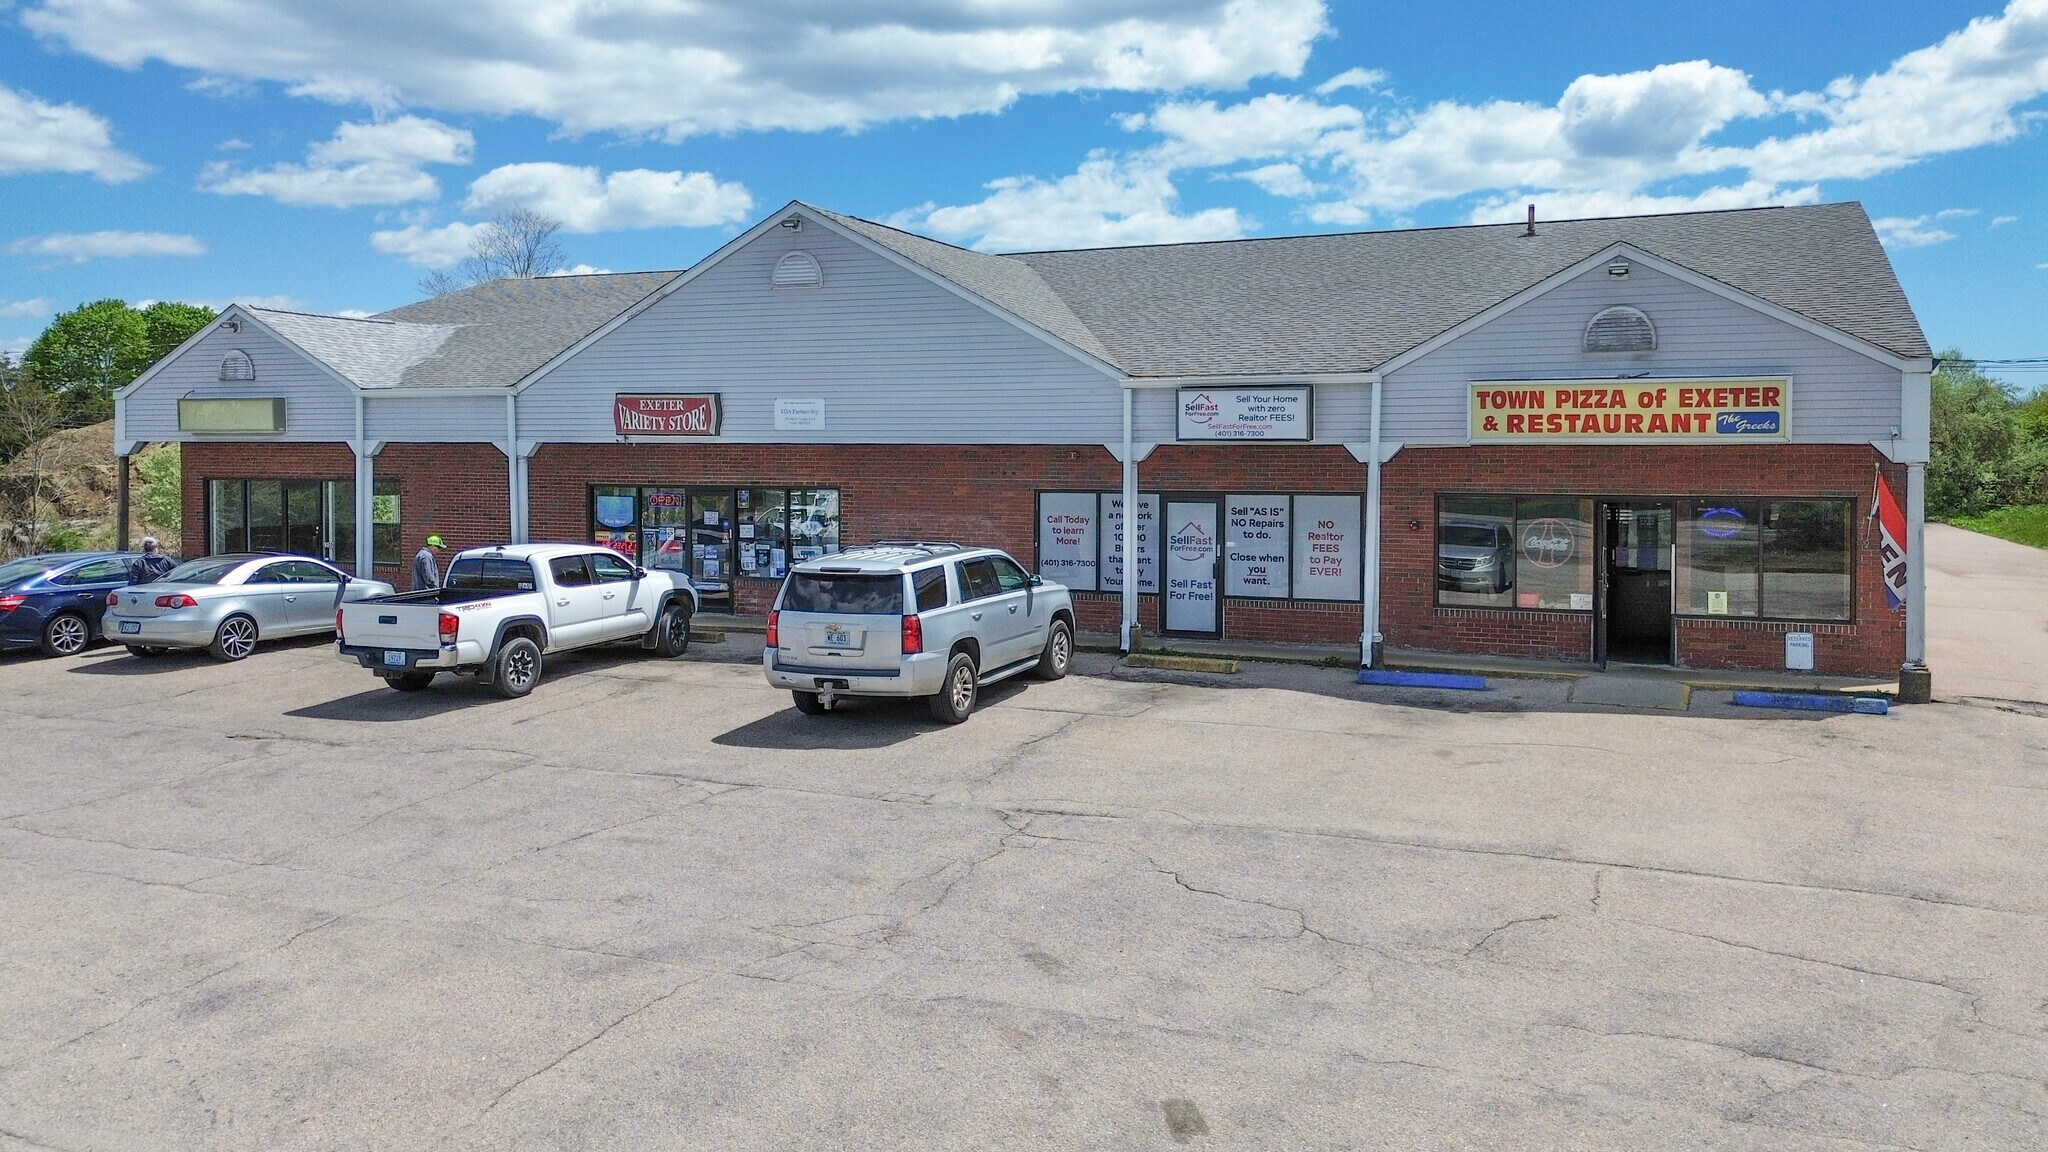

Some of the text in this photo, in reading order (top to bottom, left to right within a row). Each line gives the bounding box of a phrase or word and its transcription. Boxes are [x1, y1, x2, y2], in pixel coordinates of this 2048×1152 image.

[1236, 395, 1298, 403] Sell Your Home
[1476, 387, 1780, 409] TOWN PIZZA of EXETER
[639, 399, 684, 411] EXETER
[1185, 403, 1218, 411] SellFast
[618, 402, 707, 431] VARIETY STORE
[1238, 414, 1295, 422] Realtor FEES!
[1717, 413, 1741, 426] The
[1482, 413, 1712, 434] & RESTAURANT
[1735, 419, 1777, 433] Greeks
[1215, 430, 1232, 438] (401)
[650, 495, 681, 506] OPEN
[1231, 506, 1284, 516] Sell "AS IS"
[1047, 515, 1090, 526] Call Today
[1231, 518, 1285, 529] NO Repairs
[1318, 520, 1335, 529] NO
[1052, 526, 1085, 535] to learn
[1243, 531, 1271, 539] to do.
[1056, 537, 1081, 546] More!
[1170, 535, 1213, 545] SellFast
[1308, 532, 1344, 541] Realtor
[1312, 544, 1340, 553] FEES
[1108, 555, 1123, 564] tha
[1230, 552, 1285, 563] Close when
[1309, 556, 1342, 567] to Pay
[1880, 534, 1907, 589] EN
[742, 561, 754, 569] EBT
[1041, 559, 1096, 568] (401) 316-7300
[1247, 565, 1266, 575] you
[1309, 567, 1342, 577] EVER!
[1170, 579, 1213, 590] Sell Fast
[1243, 577, 1271, 586] want.
[1169, 591, 1213, 601] For Free!
